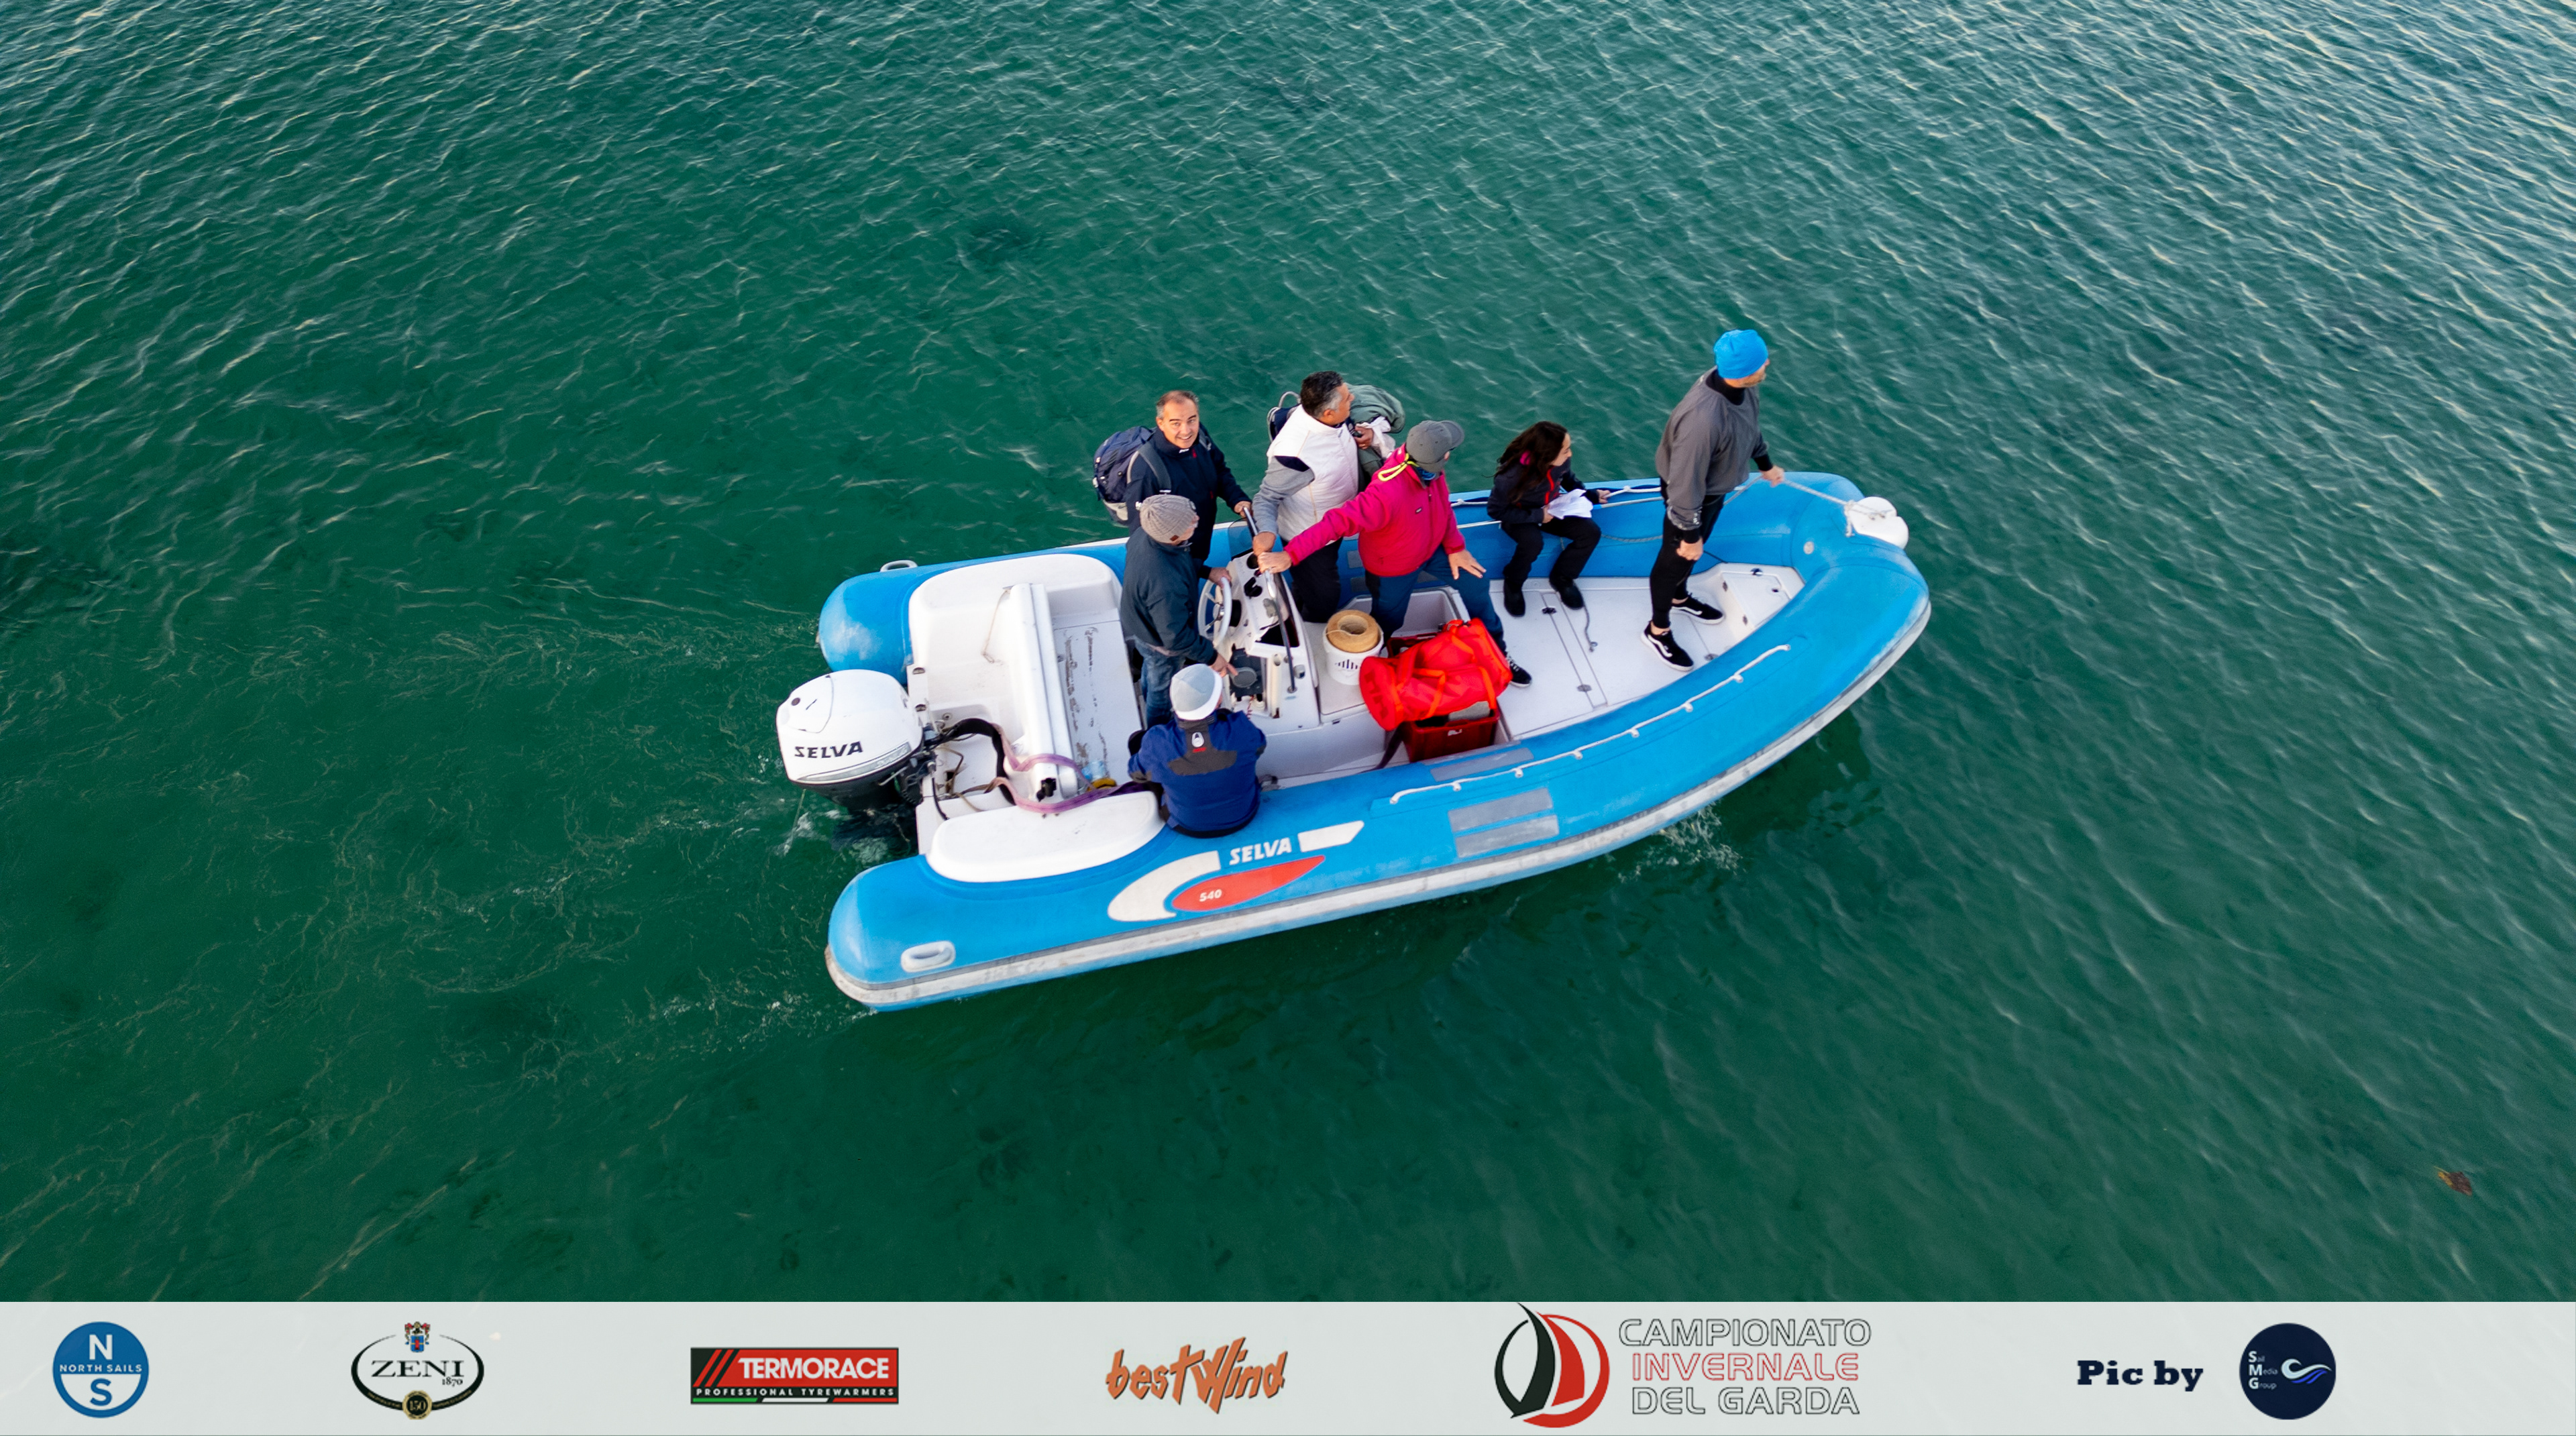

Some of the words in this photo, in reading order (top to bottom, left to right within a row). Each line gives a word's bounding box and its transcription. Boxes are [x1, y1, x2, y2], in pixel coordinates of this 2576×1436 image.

[794, 740, 863, 759] SELVA
[1229, 837, 1292, 865] SELVA
[1199, 889, 1222, 902] 540
